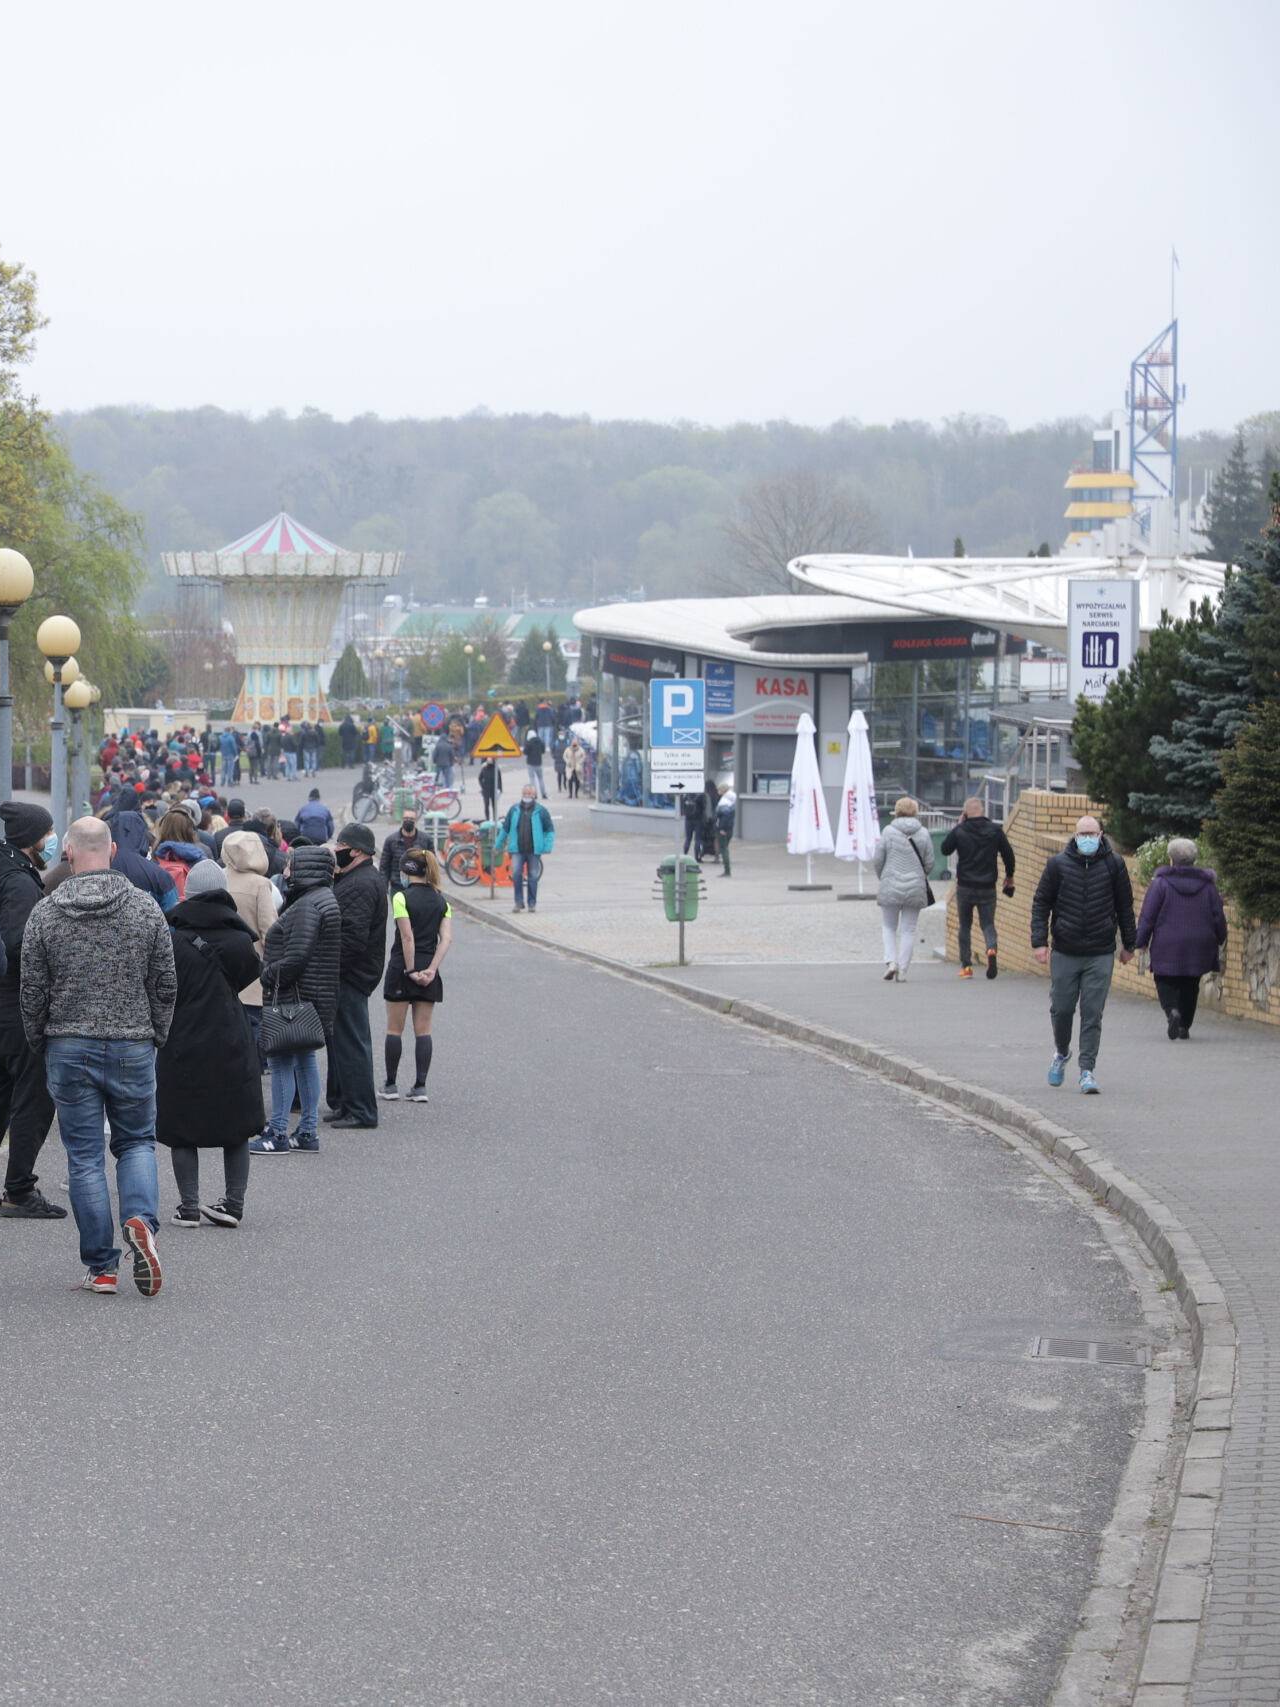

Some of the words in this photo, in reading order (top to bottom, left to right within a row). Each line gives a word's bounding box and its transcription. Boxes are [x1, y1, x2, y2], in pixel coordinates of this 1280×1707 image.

[1076, 602, 1127, 610] WYPOŻYCZALNIA
[756, 677, 809, 696] KASA
[663, 685, 694, 727] P
